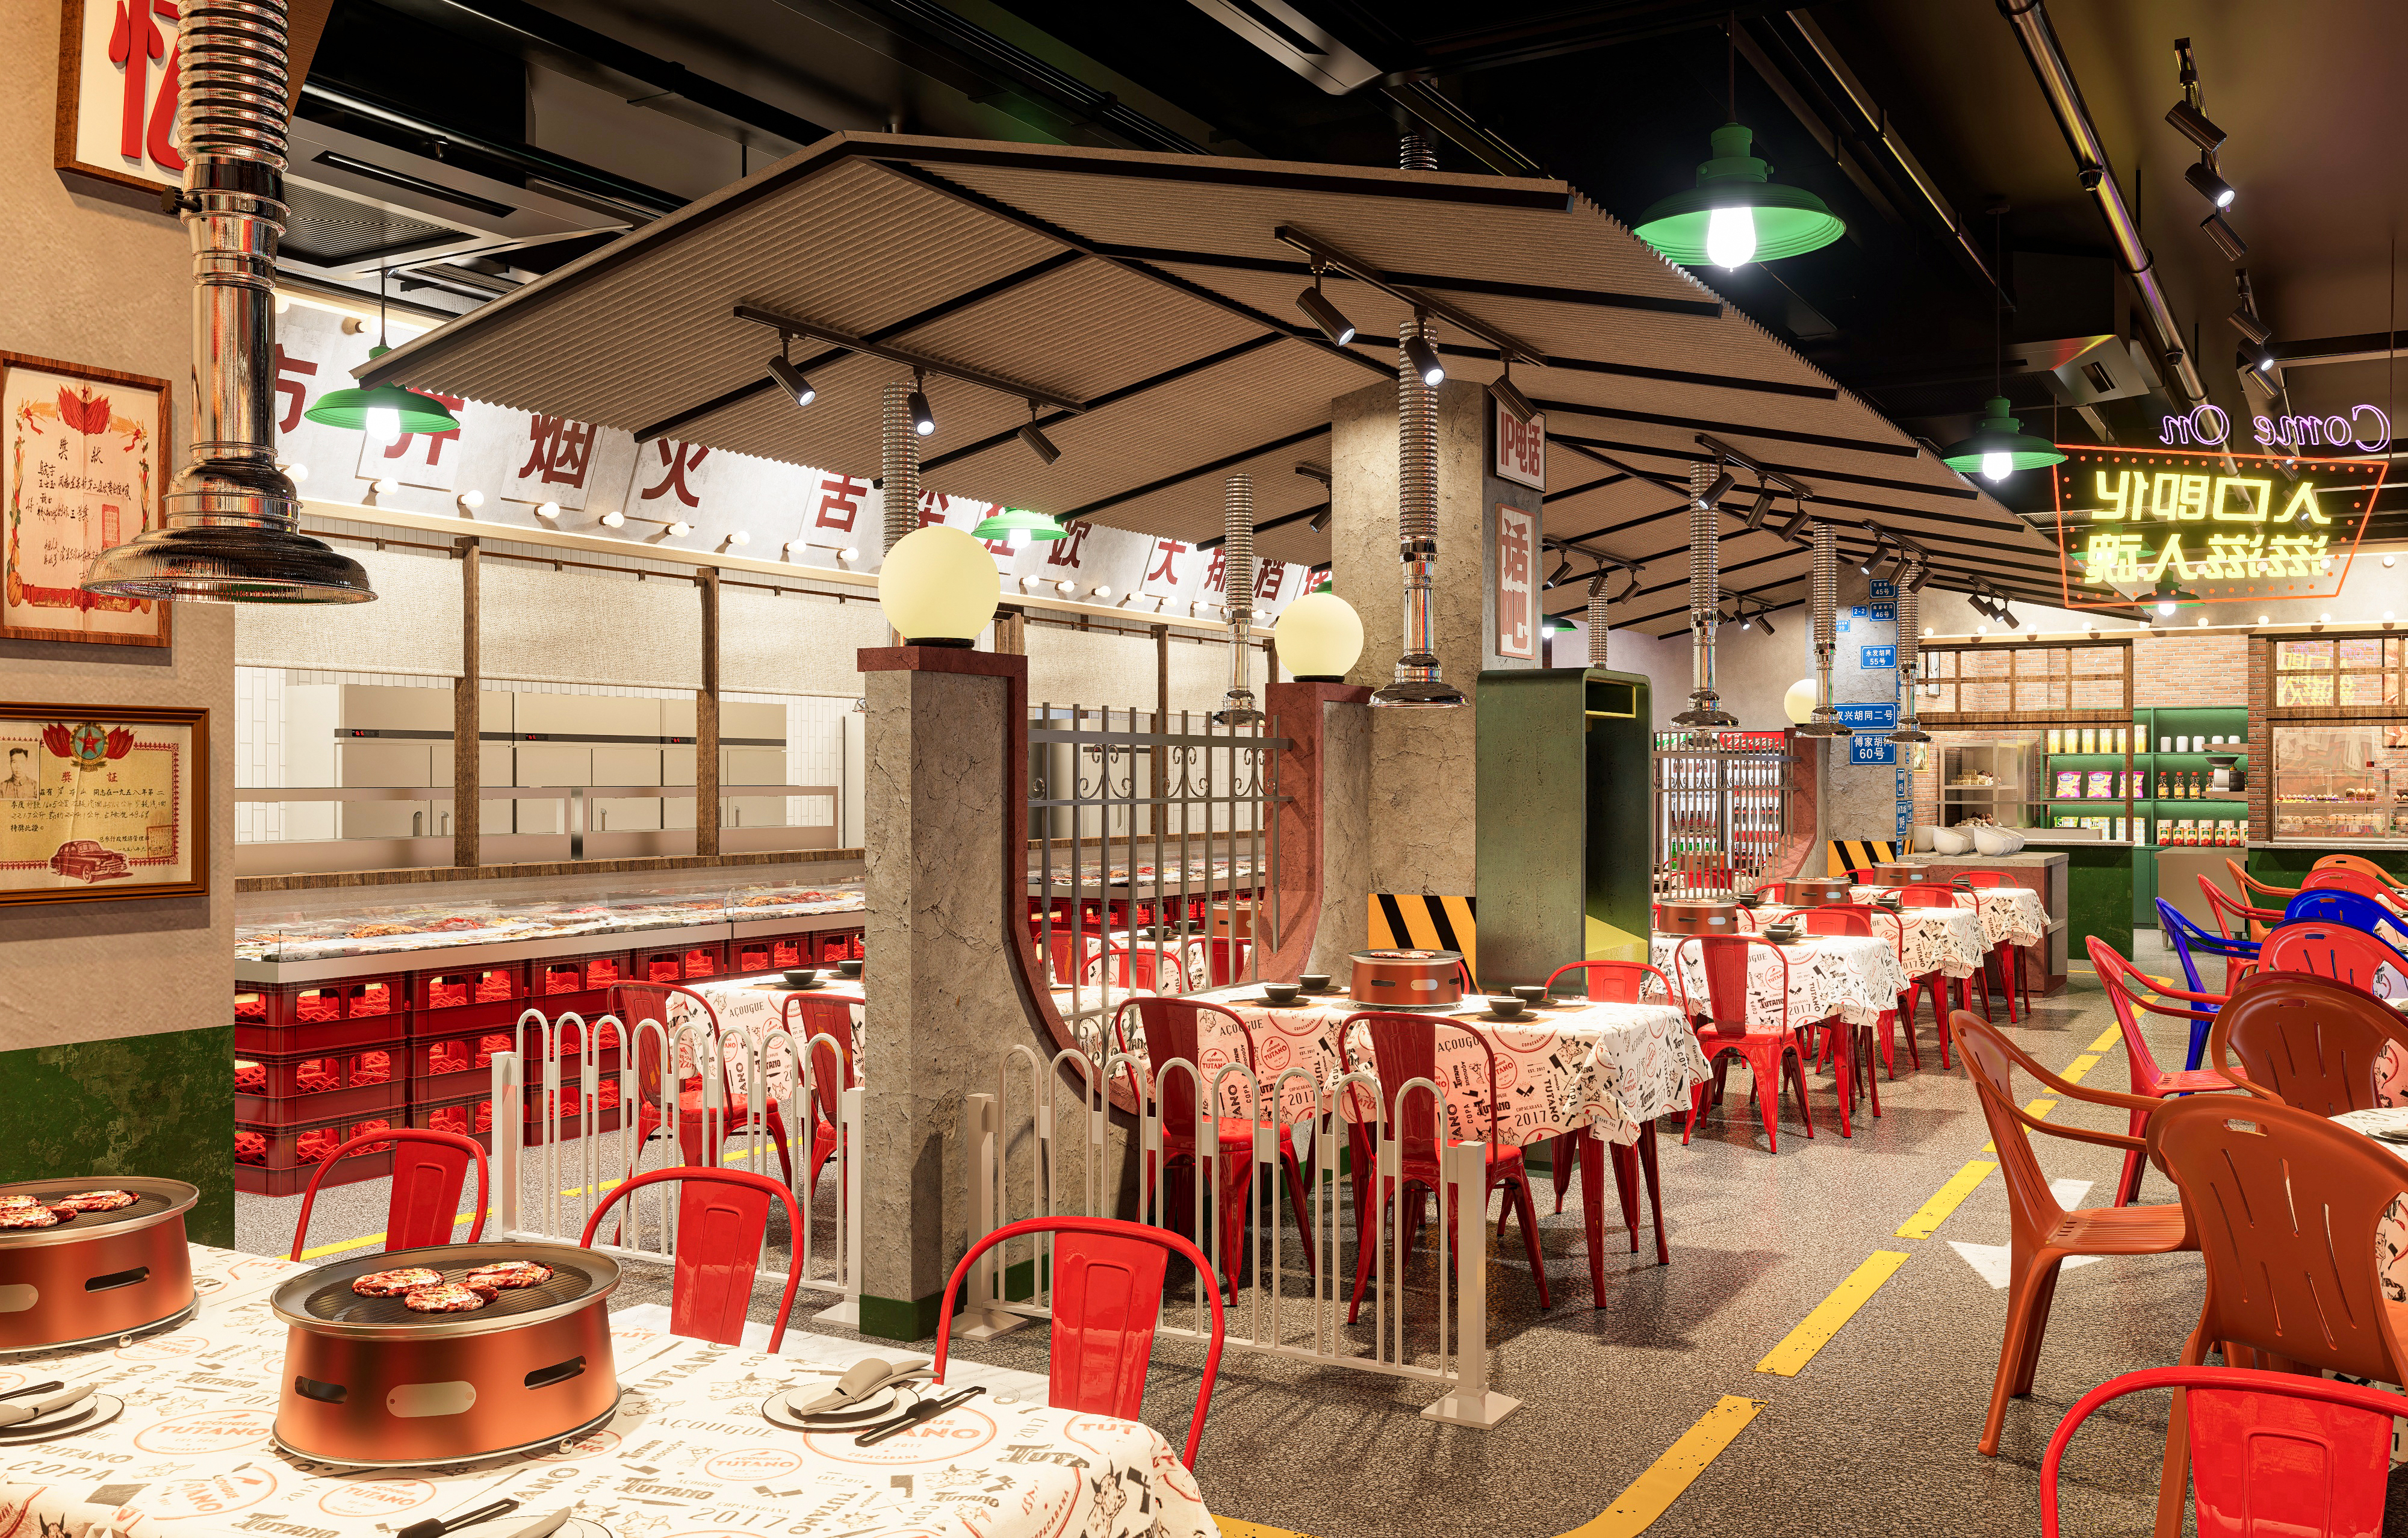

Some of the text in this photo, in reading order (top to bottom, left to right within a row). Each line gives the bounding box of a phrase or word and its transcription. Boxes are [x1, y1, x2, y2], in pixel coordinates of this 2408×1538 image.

[1502, 518, 1529, 649] 话吧
[1870, 657, 1886, 666] 55号
[1860, 748, 1885, 760] 60号
[1915, 943, 1926, 967] TUTANO
[1902, 960, 1917, 970] 017
[1808, 982, 1820, 1012] TUTANO
[729, 1001, 765, 1018] AÇOUGUE
[1787, 1003, 1811, 1016] 2017
[1294, 1019, 1317, 1031] COPACABANA
[1437, 1035, 1480, 1053] AÇOUGU
[1521, 1034, 1546, 1047] COPACABANA
[1264, 1045, 1287, 1061] TUTANO
[1461, 1061, 1470, 1086] AÇOUGUE
[1516, 1103, 1543, 1112] COPACABANA
[1544, 1079, 1560, 1123] TUTANO
[1447, 1103, 1463, 1138] ANO
[1463, 1103, 1474, 1124] COPA
[1515, 1110, 1547, 1127] 2017
[141, 1369, 182, 1385] COPA
[158, 1425, 271, 1436] TUTANO
[647, 1417, 783, 1439] AÇOUGUE
[1014, 1418, 1049, 1438] 2017
[28, 1444, 134, 1464] TUTANO
[5, 1460, 116, 1481] COPA
[281, 1484, 321, 1502] 2017
[574, 1475, 613, 1494] COPA
[613, 1476, 715, 1501] TUTANO
[343, 1487, 417, 1506] TUTANO
[716, 1501, 792, 1515] COPACABANA
[788, 1492, 859, 1535] TUTANO
[901, 1505, 940, 1527] COPA
[687, 1507, 789, 1529] 2017
